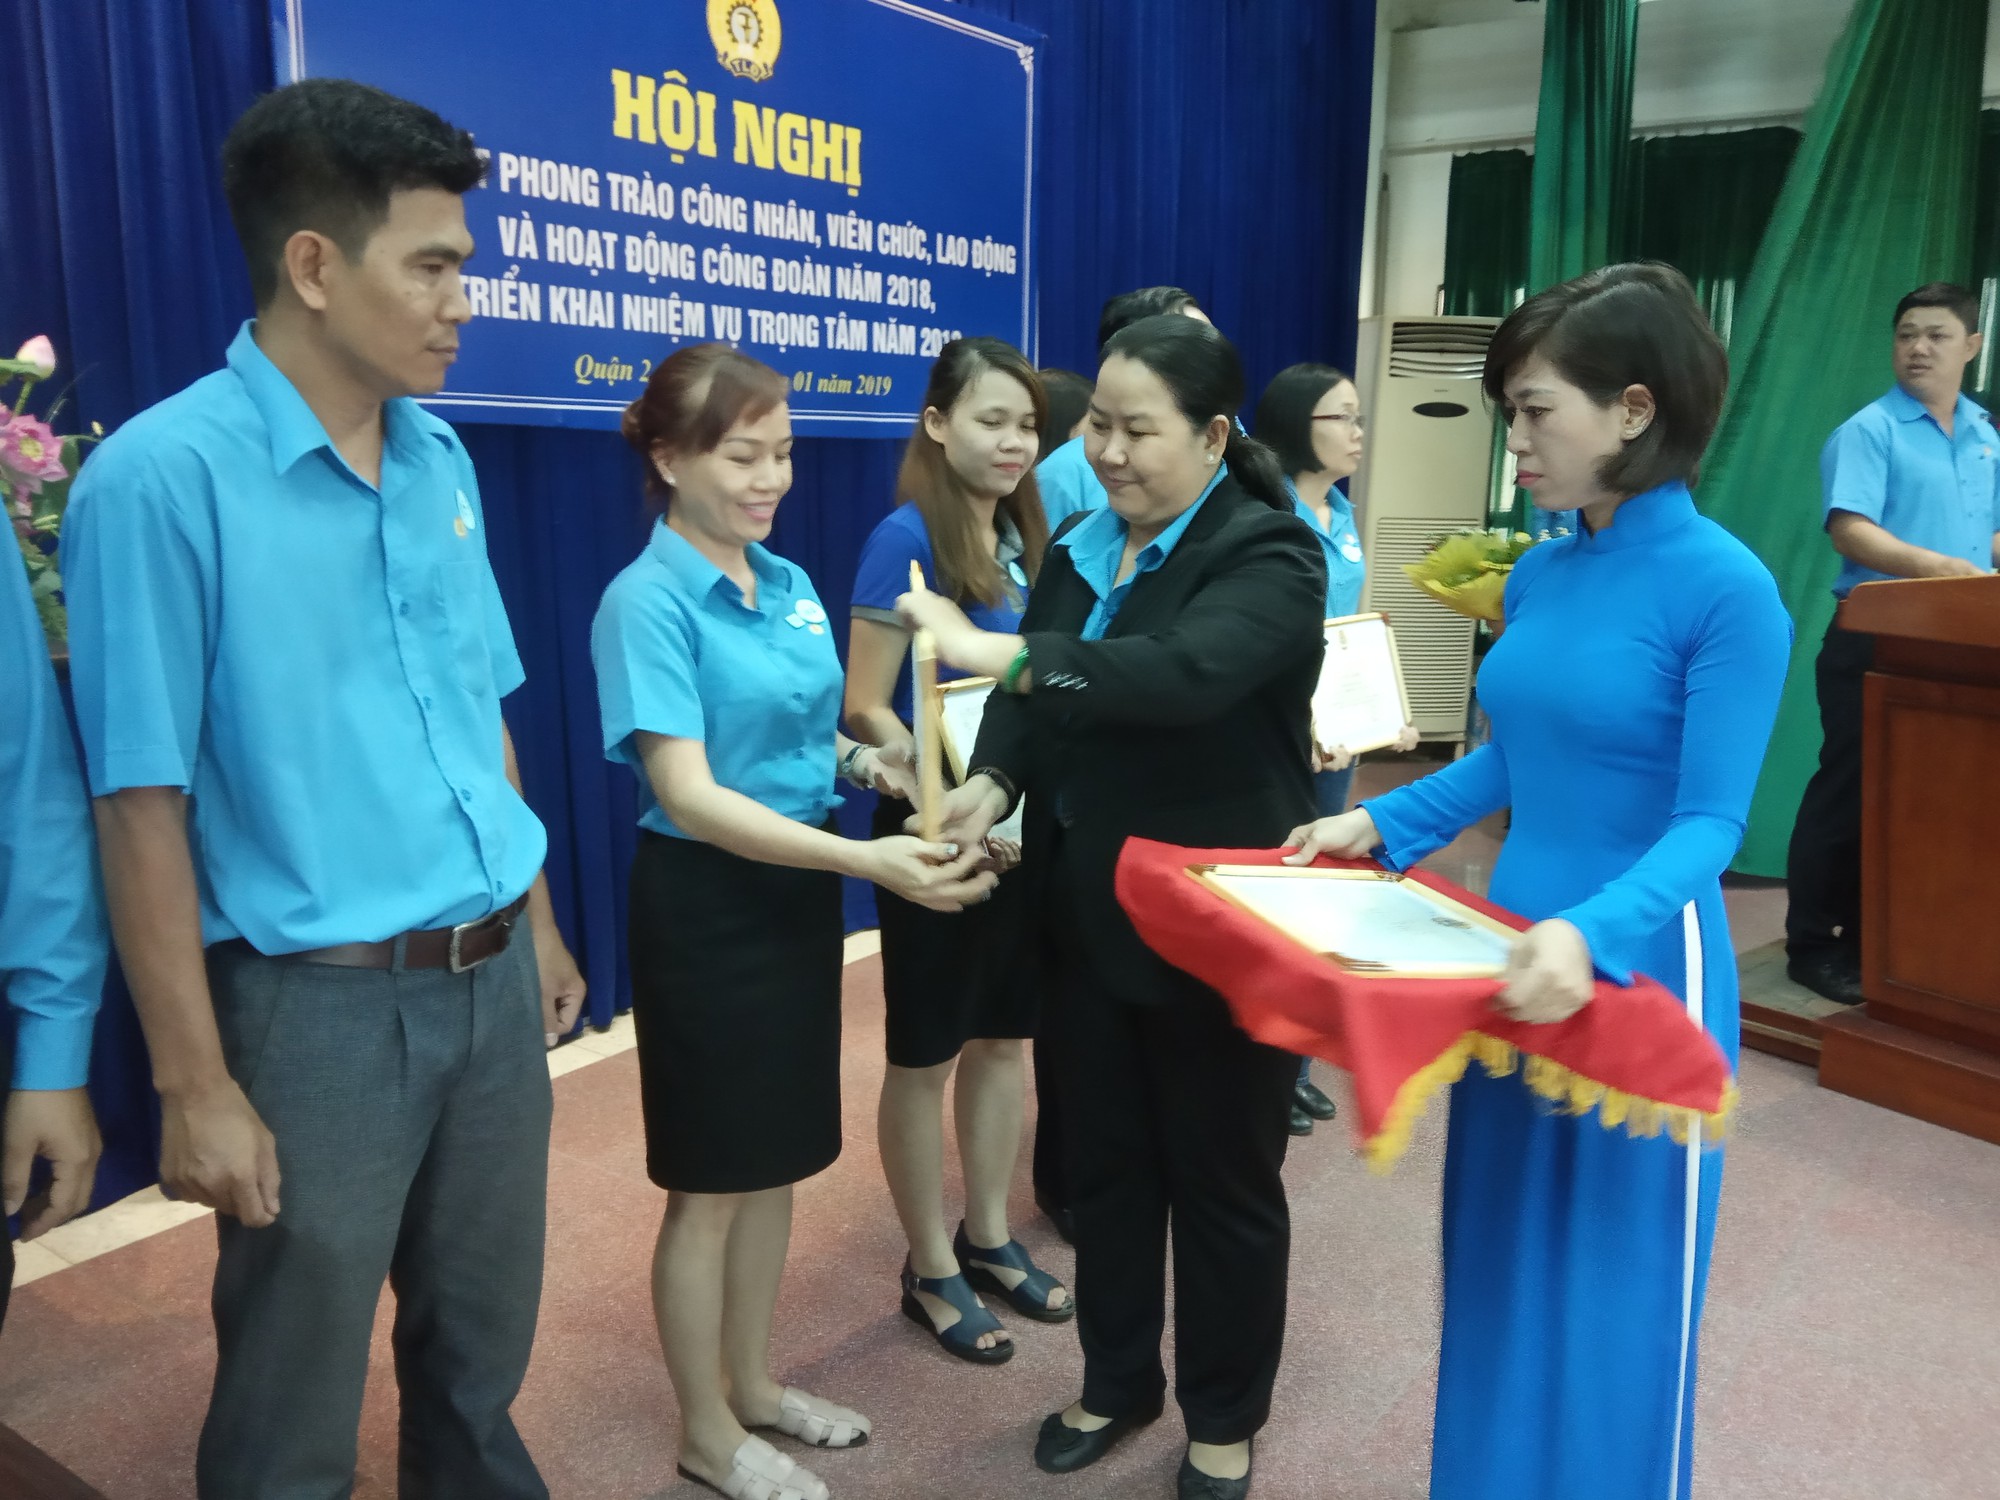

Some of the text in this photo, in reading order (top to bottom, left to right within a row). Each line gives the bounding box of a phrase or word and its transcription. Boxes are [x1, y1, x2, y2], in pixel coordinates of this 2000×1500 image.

[611, 68, 862, 197] HỘI NGHỊ
[498, 210, 936, 314] VÀ HOẠT ĐỘNG CÔNG ĐOÀN NĂM 2018,
[499, 152, 599, 208] PHONG
[606, 171, 675, 220] TRÀO
[681, 183, 748, 233] CÔNG
[753, 199, 821, 249] NHÂN,
[826, 209, 873, 252] VIÊN
[877, 220, 932, 265] CHỨC,
[936, 232, 968, 267] LAO
[971, 235, 1016, 277] ĐỘNG
[549, 285, 615, 329] KHAI
[622, 292, 705, 343] NHIỆM
[711, 304, 742, 349] VỤ
[748, 309, 820, 353] TRỌNG
[824, 311, 868, 352] TÂM
[872, 317, 916, 356] NĂM
[574, 353, 633, 387] Quận
[793, 371, 812, 392] 01
[817, 374, 852, 394] năm
[855, 375, 892, 396] 2019
